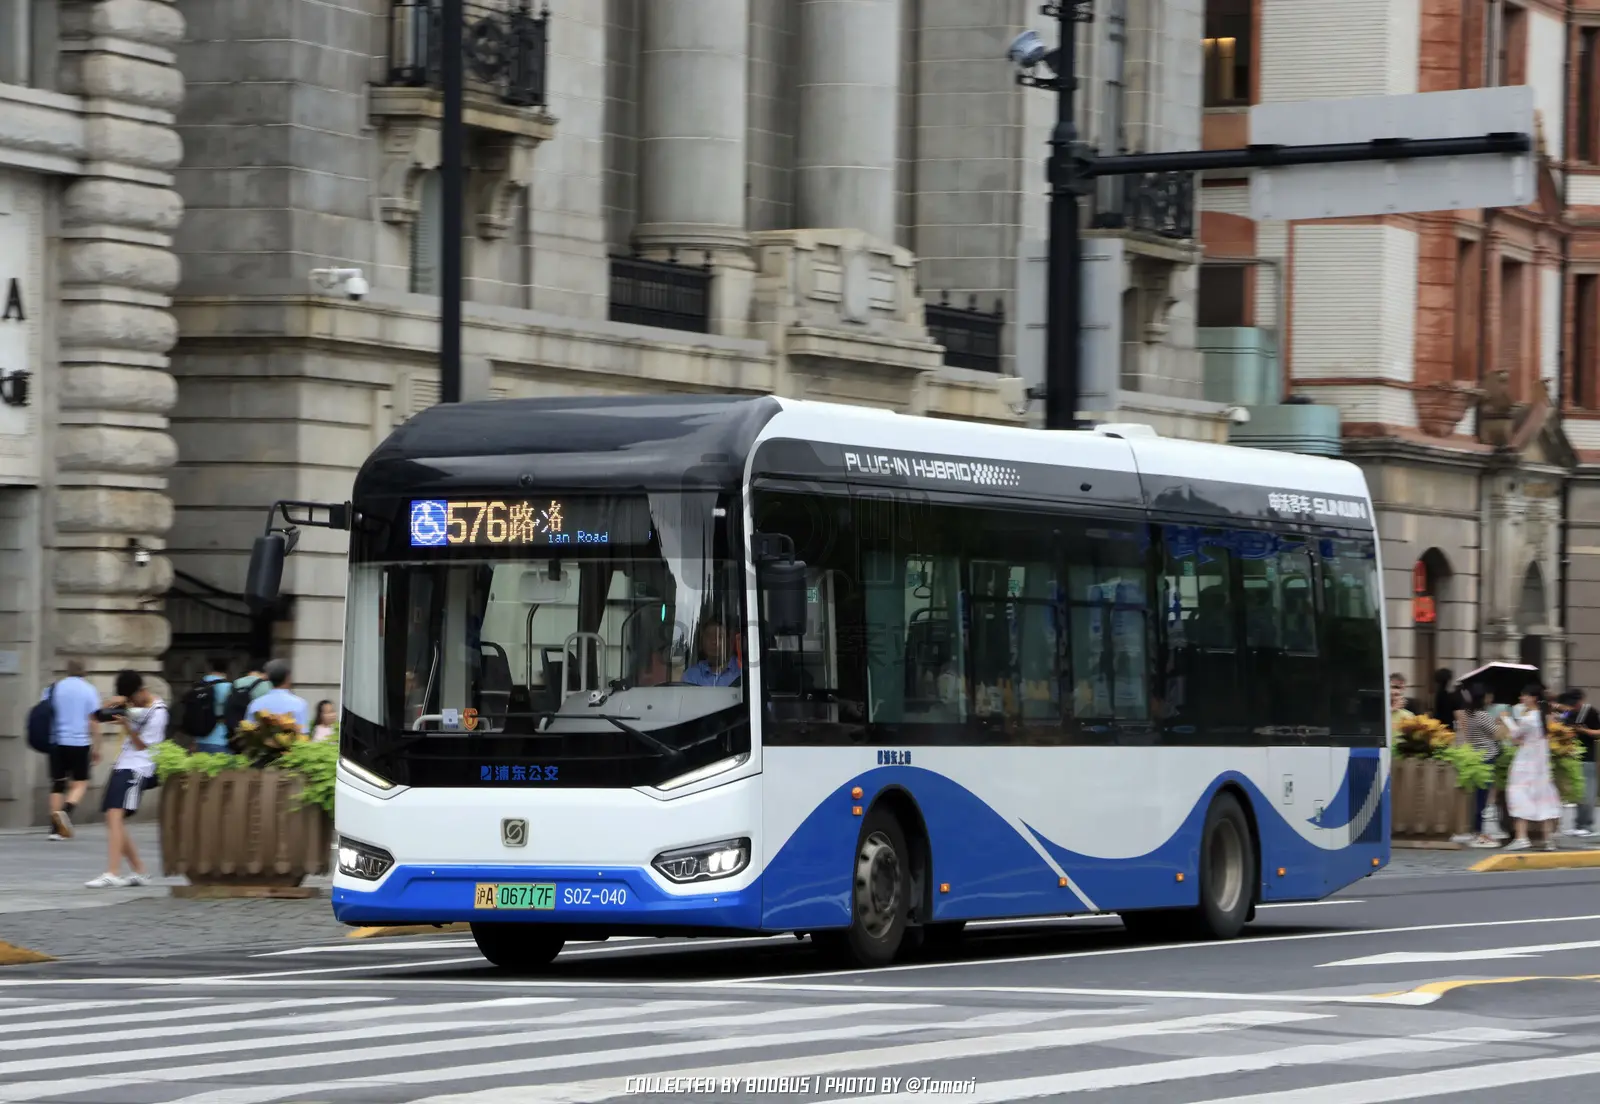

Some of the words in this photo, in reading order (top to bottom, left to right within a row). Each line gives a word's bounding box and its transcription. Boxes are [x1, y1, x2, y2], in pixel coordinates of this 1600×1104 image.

[845, 452, 910, 476] PLUG-IN
[912, 458, 972, 482] HYBRID
[447, 500, 534, 543] 576路
[577, 531, 609, 543] Road
[495, 765, 558, 780] 浦东公交
[501, 887, 554, 906] 06717F
